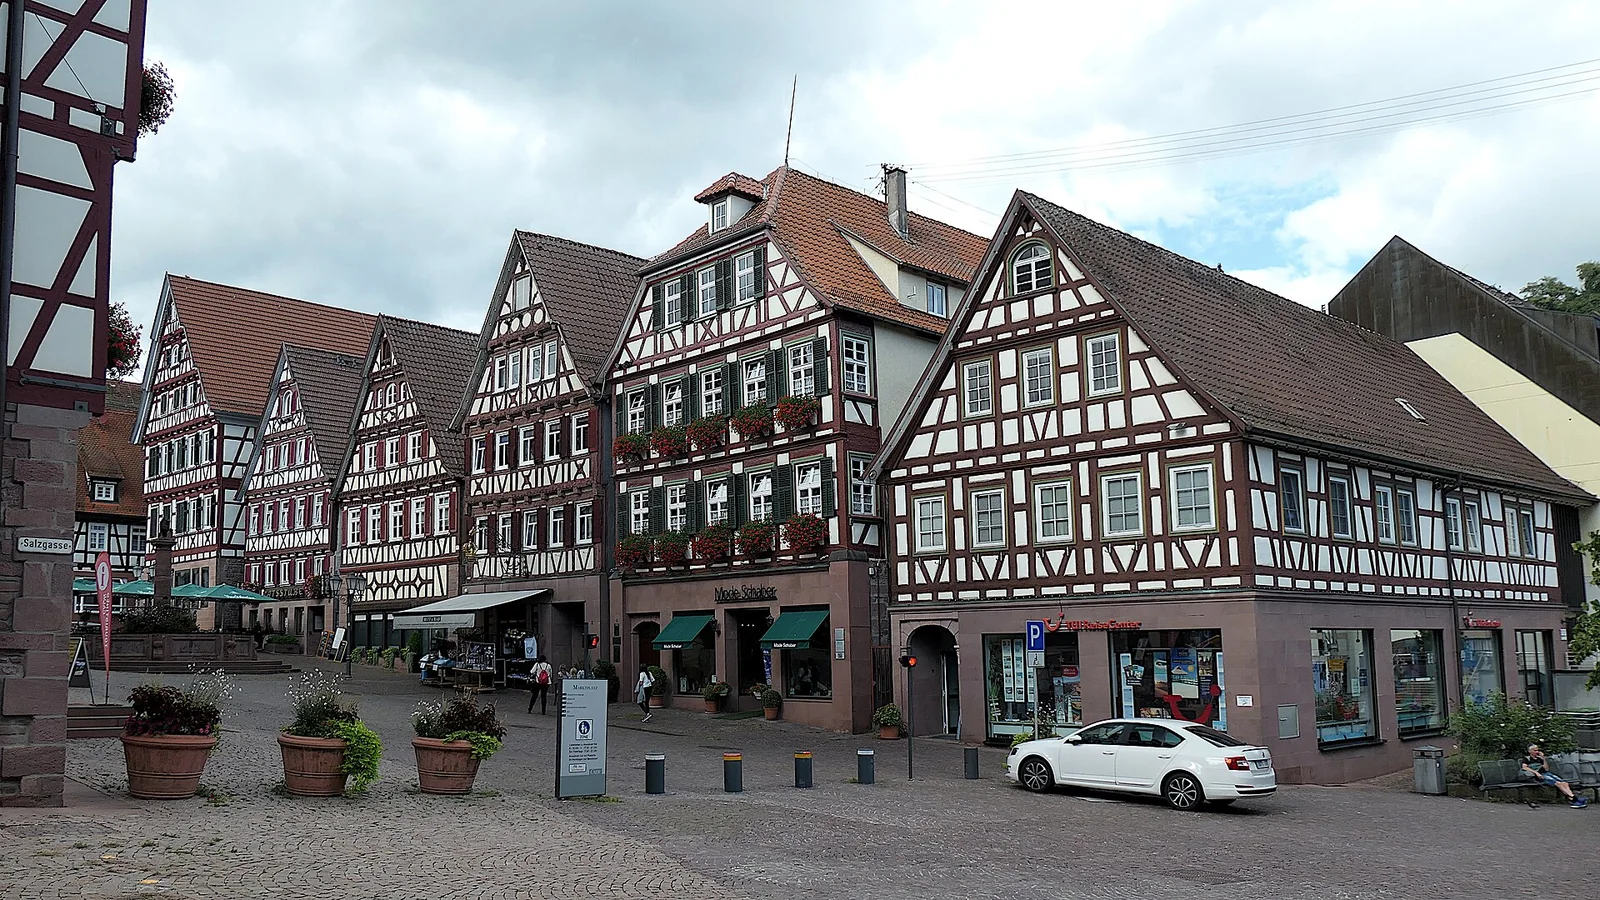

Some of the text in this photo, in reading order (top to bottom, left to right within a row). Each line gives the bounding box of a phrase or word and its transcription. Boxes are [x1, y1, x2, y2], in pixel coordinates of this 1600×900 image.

[23, 538, 69, 551] Salzgasse
[264, 587, 303, 597] ATSSTUBE
[714, 582, 777, 602] Mode Schaber
[1066, 620, 1082, 629] TUI
[1030, 624, 1040, 647] P
